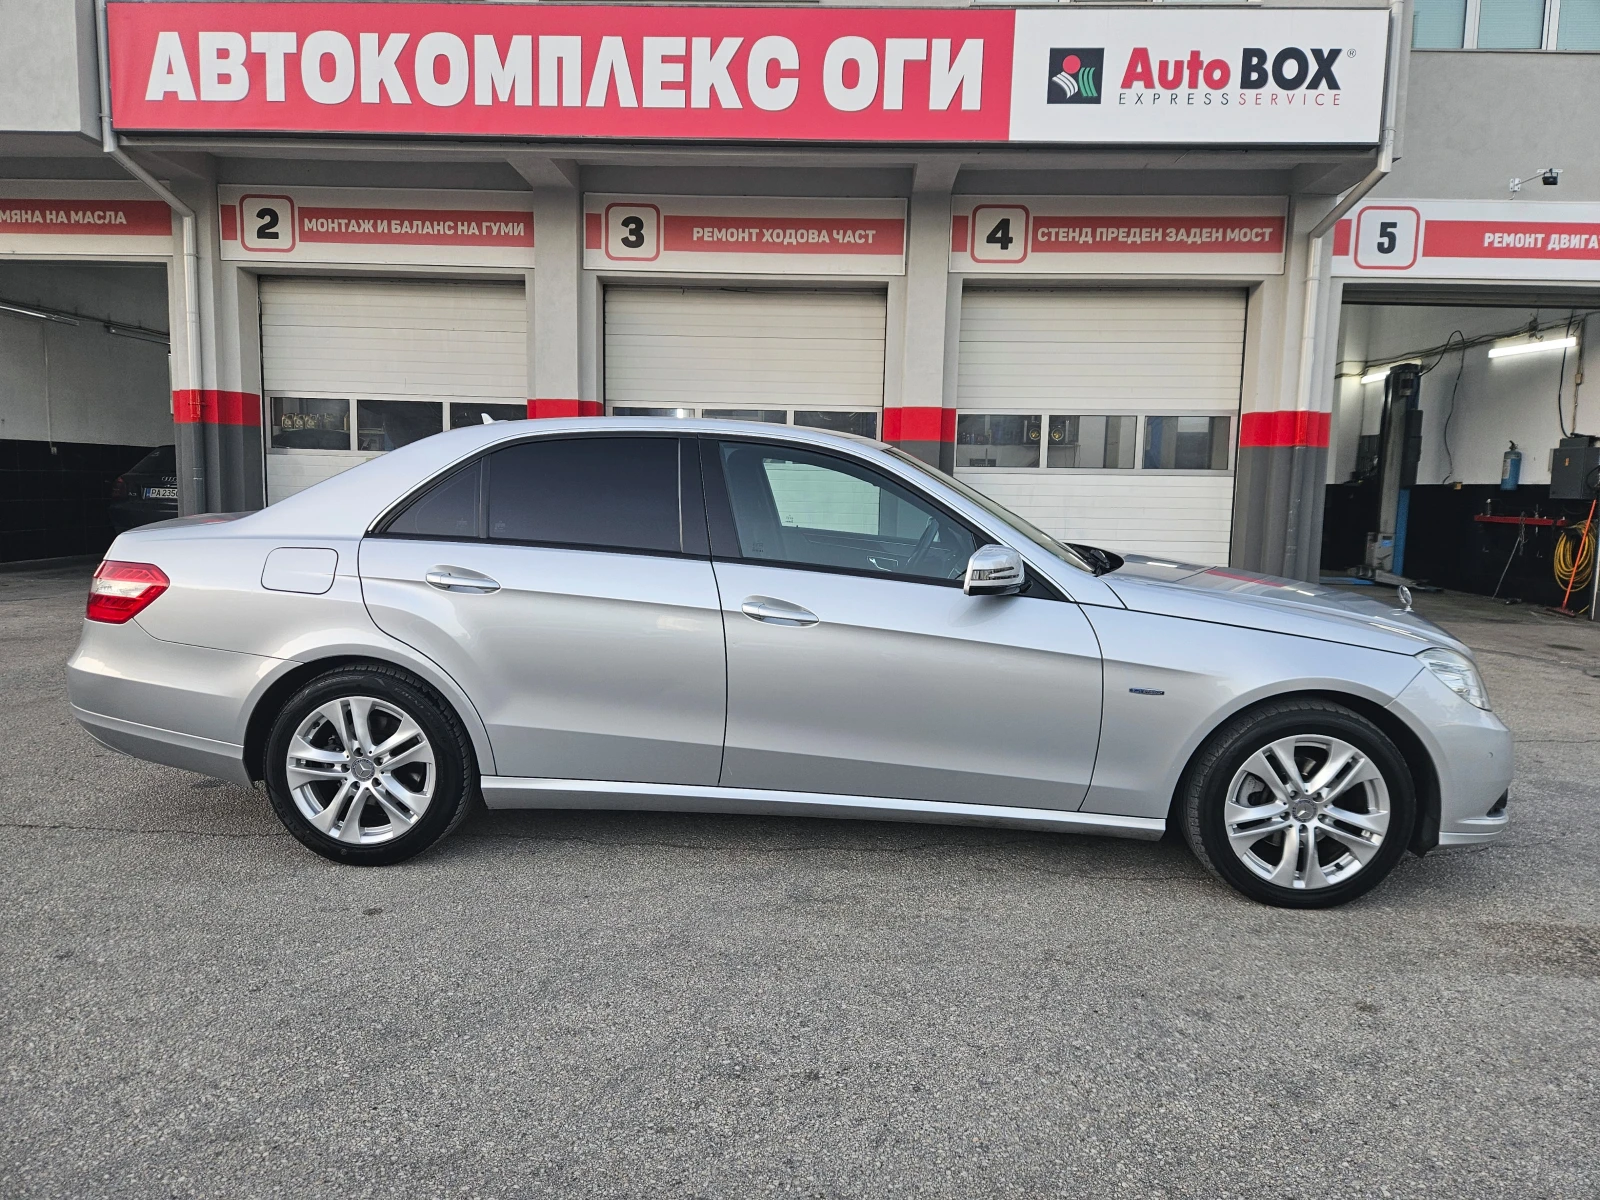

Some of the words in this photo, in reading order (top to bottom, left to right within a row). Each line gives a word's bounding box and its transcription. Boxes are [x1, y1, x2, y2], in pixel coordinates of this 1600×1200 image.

[145, 30, 800, 110] АВТОКОМПЛЕКС
[823, 35, 984, 111] ОГИ
[1120, 47, 1231, 90] Auto
[1240, 46, 1343, 91] BOX
[46, 210, 68, 224] НА
[71, 211, 127, 225] МАСЛА
[256, 207, 280, 239] 2
[304, 218, 375, 233] МОНТАЖ
[378, 220, 389, 233] И
[391, 220, 454, 235] БАЛАНС
[458, 221, 480, 235] НА
[482, 221, 525, 237] ГУМИ
[620, 216, 645, 248] 3
[693, 227, 759, 242] РЕМОНТ
[762, 228, 830, 245] ХОДОВА
[833, 230, 876, 244] ЧАСТ
[986, 218, 1014, 250] 4
[1037, 227, 1093, 244] СТЕНД
[1095, 227, 1163, 244] ПРЕДЕН
[1166, 227, 1223, 244] ЗАДЕН
[1226, 227, 1273, 243] МОСТ
[1376, 222, 1398, 254] 5
[1484, 232, 1546, 248] РЕМОНТ
[1547, 233, 1600, 251] ДВИГА
